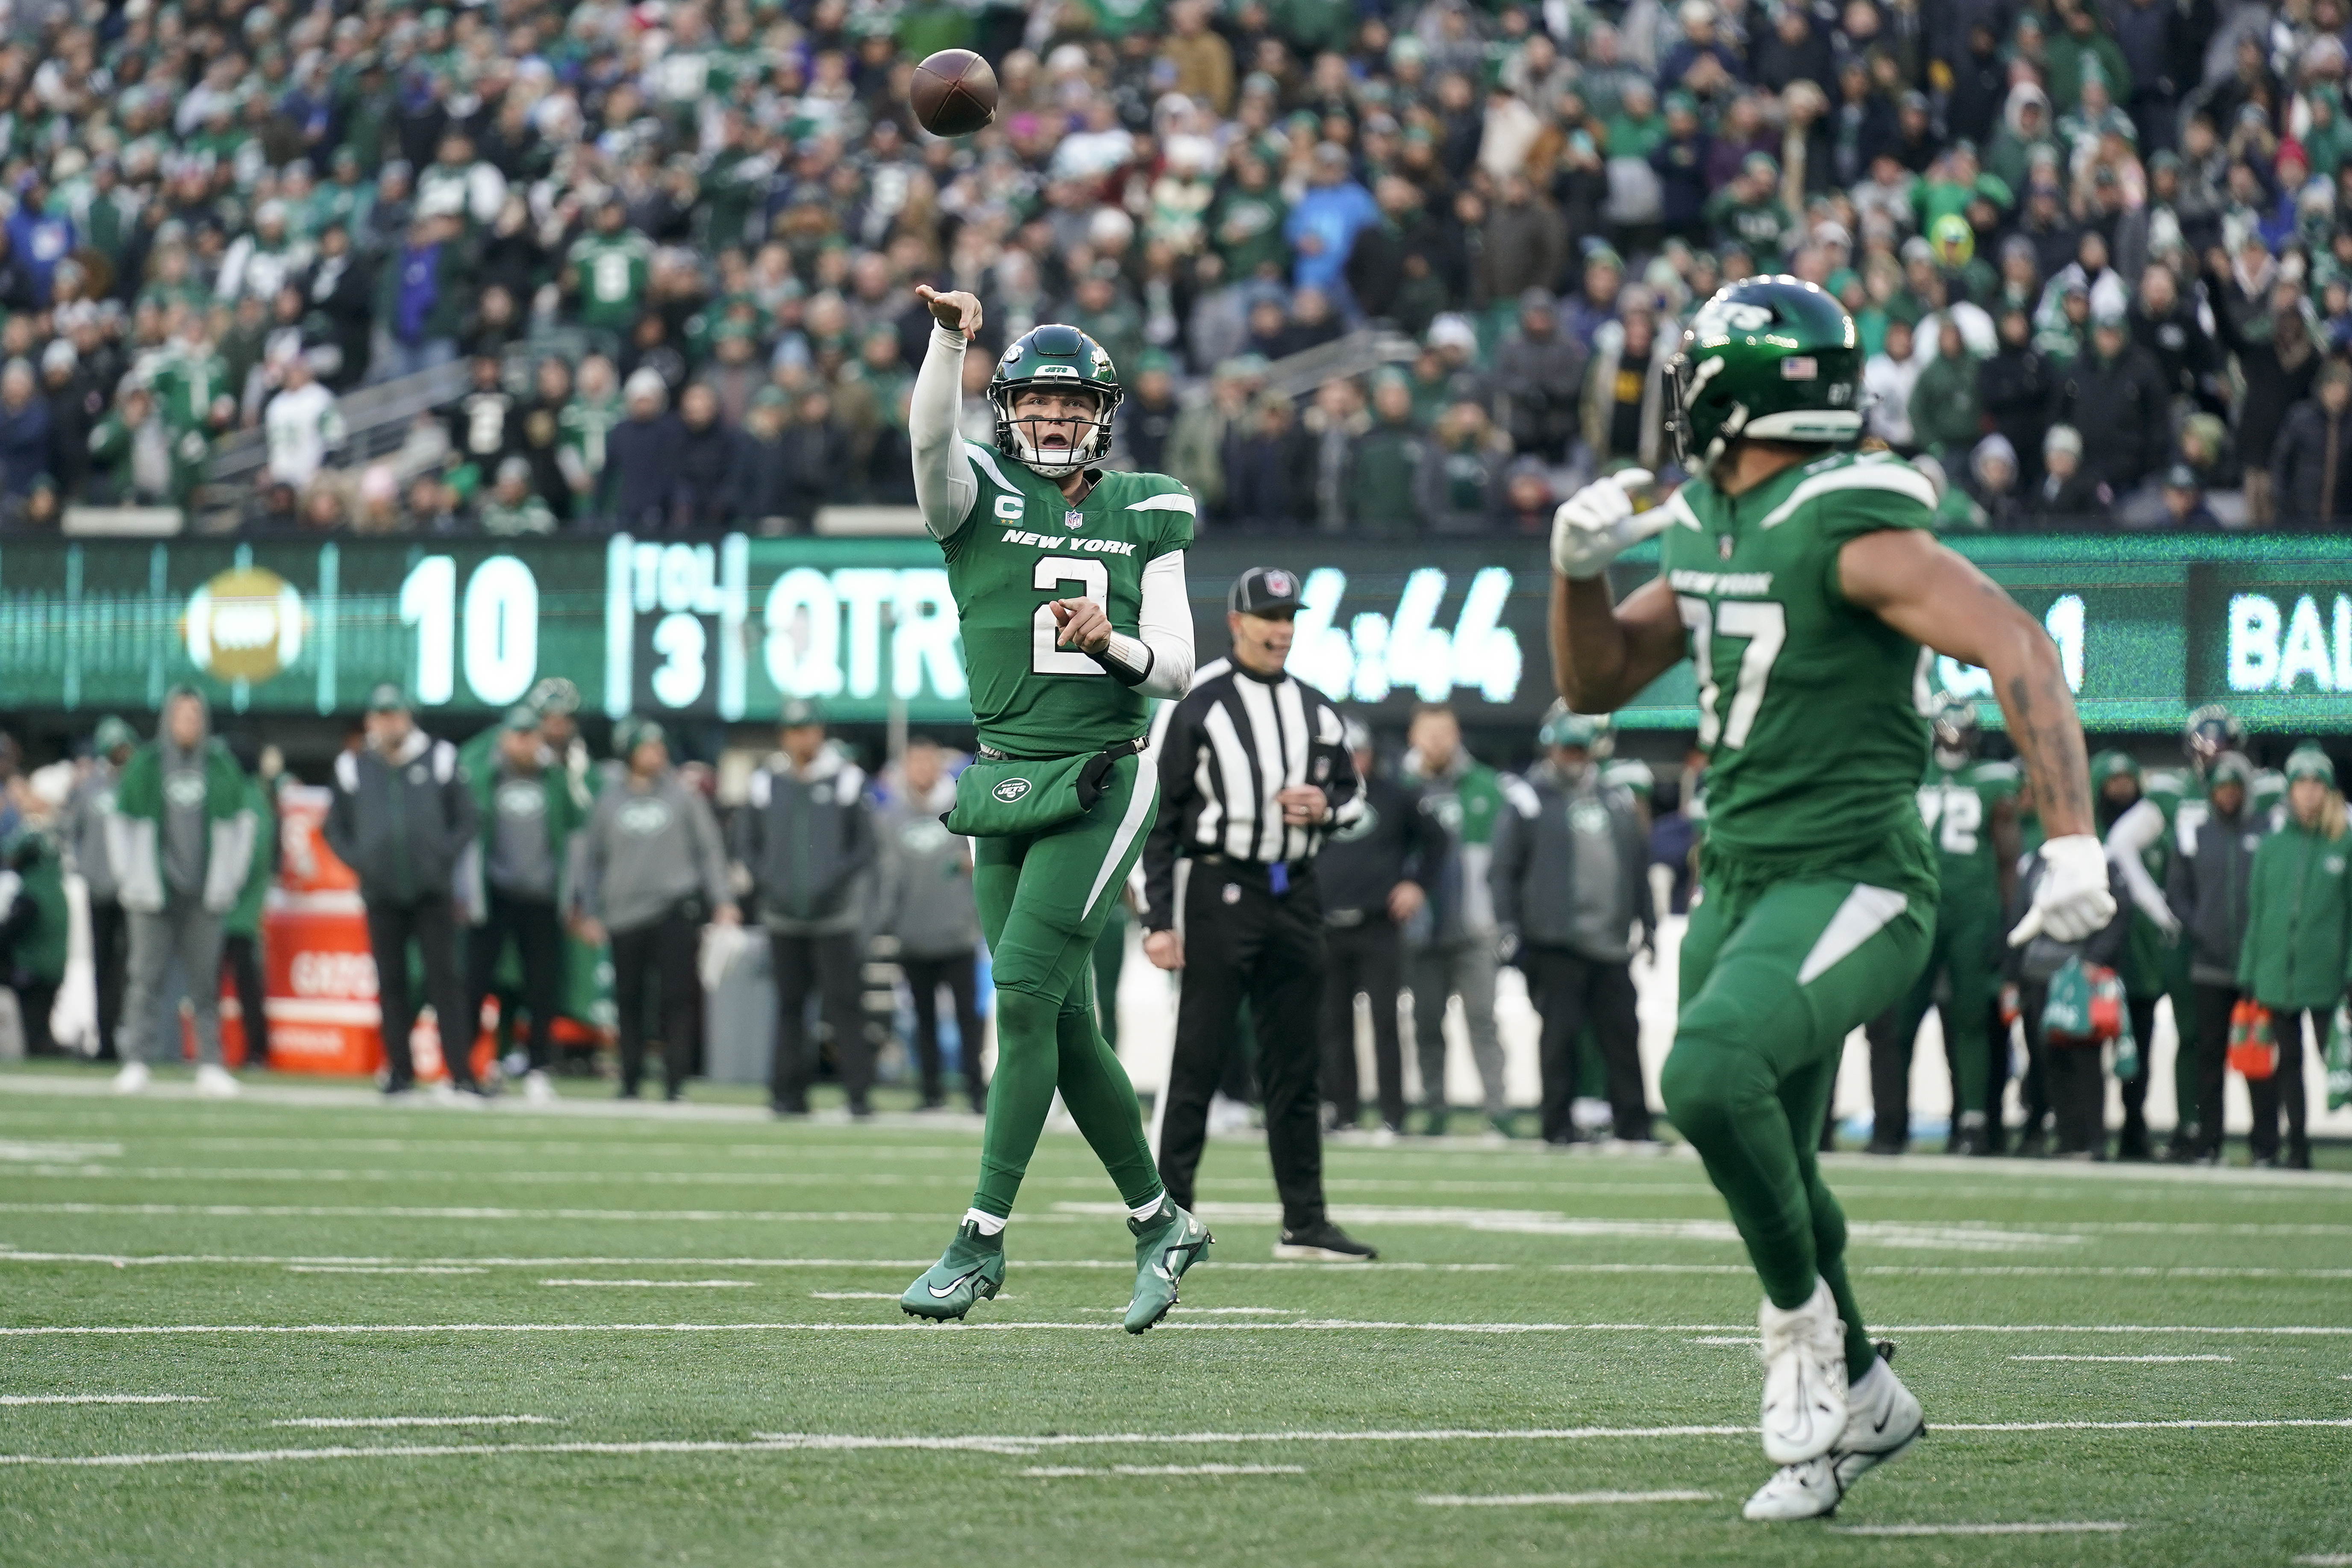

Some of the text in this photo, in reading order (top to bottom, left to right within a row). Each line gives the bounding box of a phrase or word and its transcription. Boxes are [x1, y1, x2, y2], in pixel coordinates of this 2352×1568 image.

[994, 494, 1024, 520] C
[1001, 529, 1137, 557] NEW YORK
[398, 554, 539, 706] 10
[764, 566, 967, 700] QTR
[1031, 553, 1111, 677] 2
[651, 612, 707, 708] 3
[997, 785, 1026, 795] JETS
[1915, 785, 1983, 855] 72
